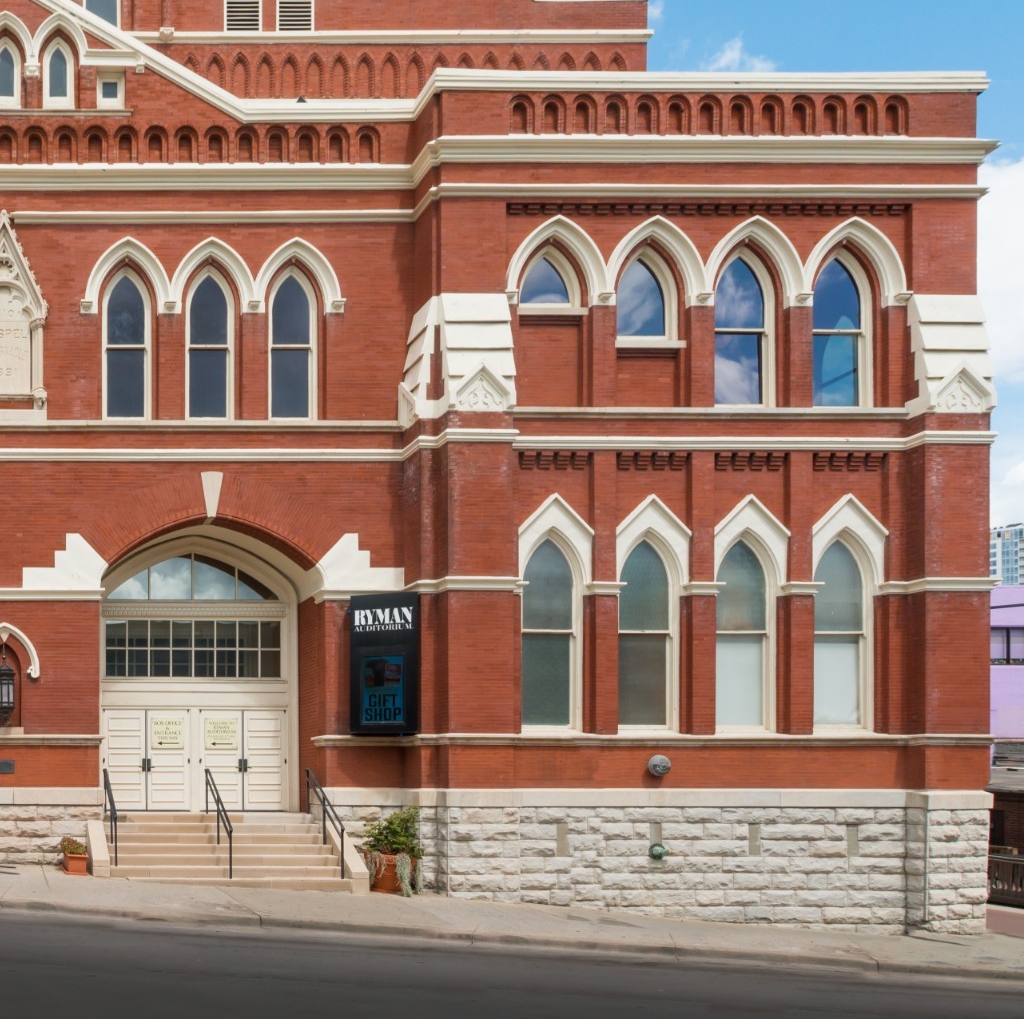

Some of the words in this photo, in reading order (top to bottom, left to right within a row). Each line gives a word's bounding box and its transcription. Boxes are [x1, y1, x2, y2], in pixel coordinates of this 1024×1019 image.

[354, 606, 413, 626] RYMAN
[368, 694, 398, 707] GIFT
[365, 707, 402, 721] SHOP
